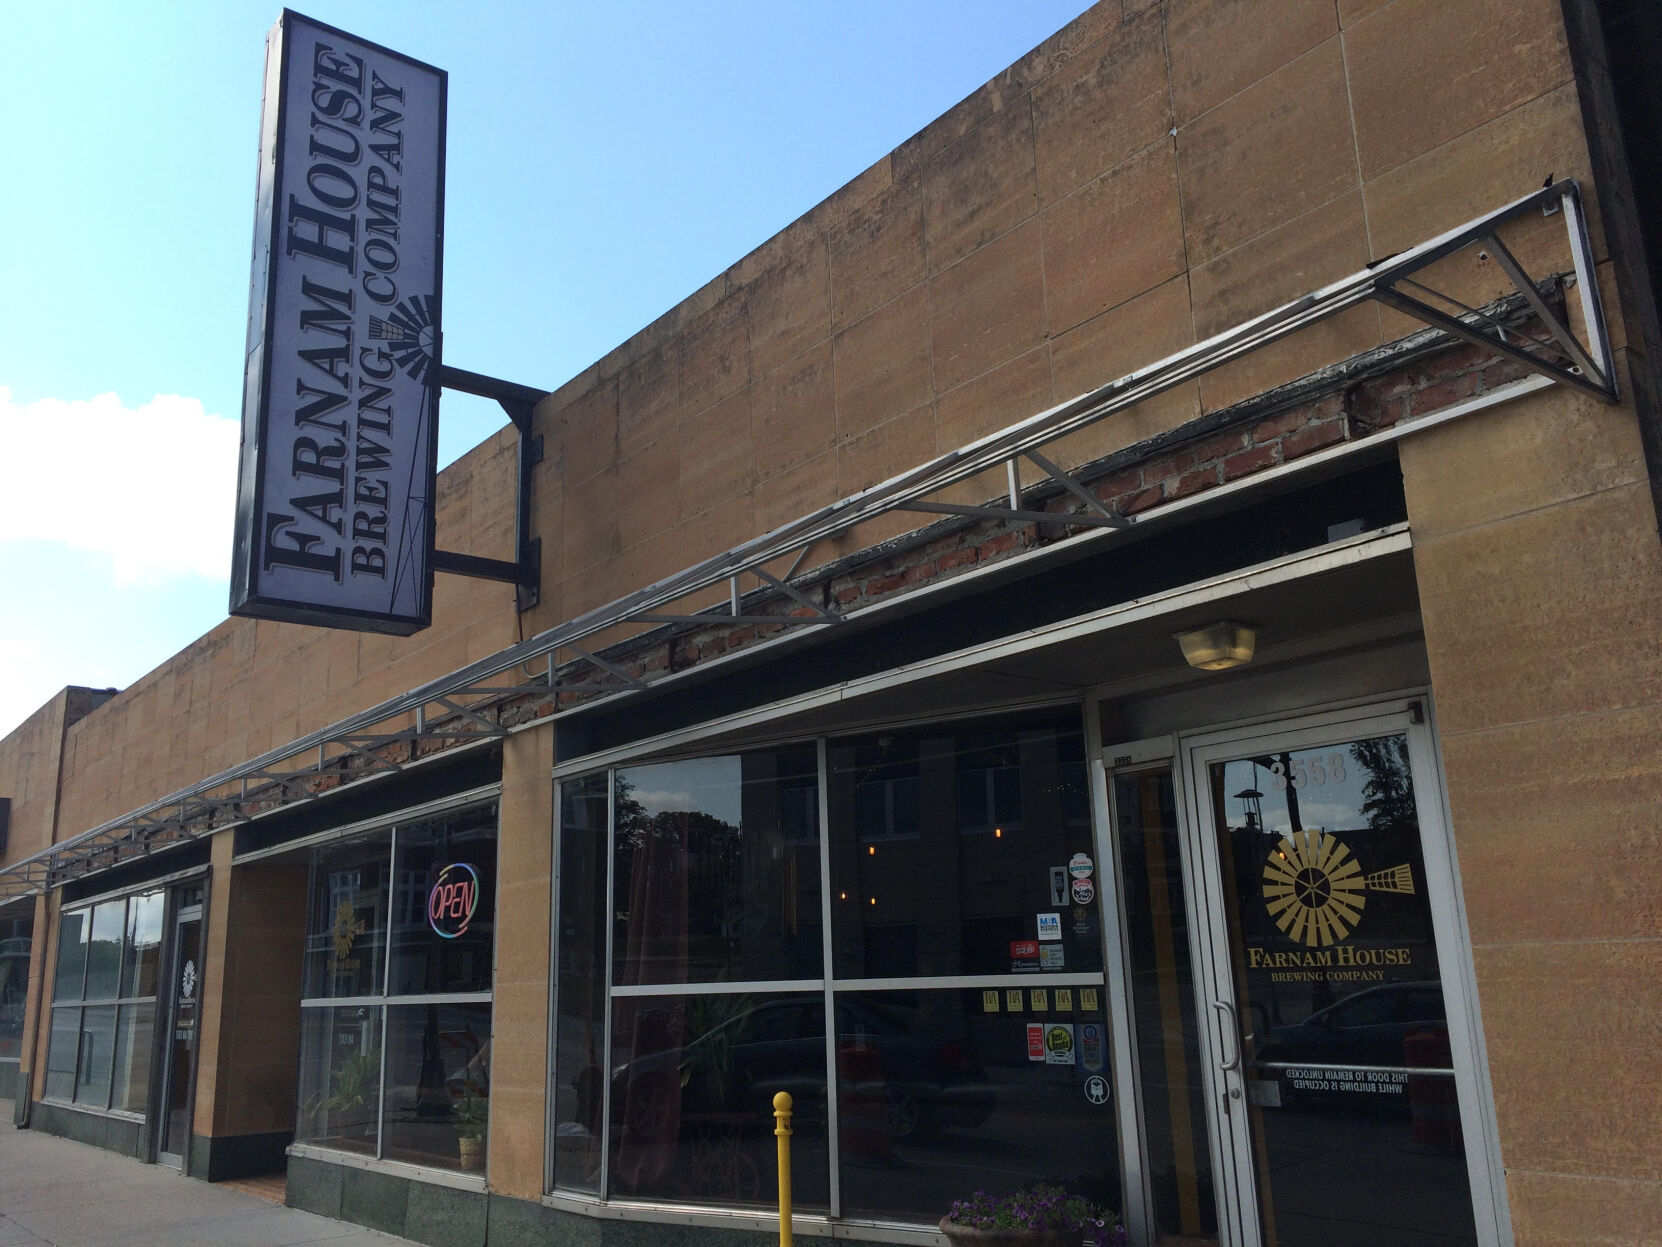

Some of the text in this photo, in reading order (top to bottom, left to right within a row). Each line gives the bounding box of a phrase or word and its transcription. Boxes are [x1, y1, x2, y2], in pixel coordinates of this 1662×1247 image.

[264, 42, 366, 584] FARNAM HOUSE
[351, 70, 405, 582] BREWING COMPANY
[1270, 753, 1346, 790] 3558
[432, 881, 475, 919] OPEN
[1248, 946, 1412, 968] FARNAM HOUSE
[1271, 971, 1385, 982] BREWING COMPANY
